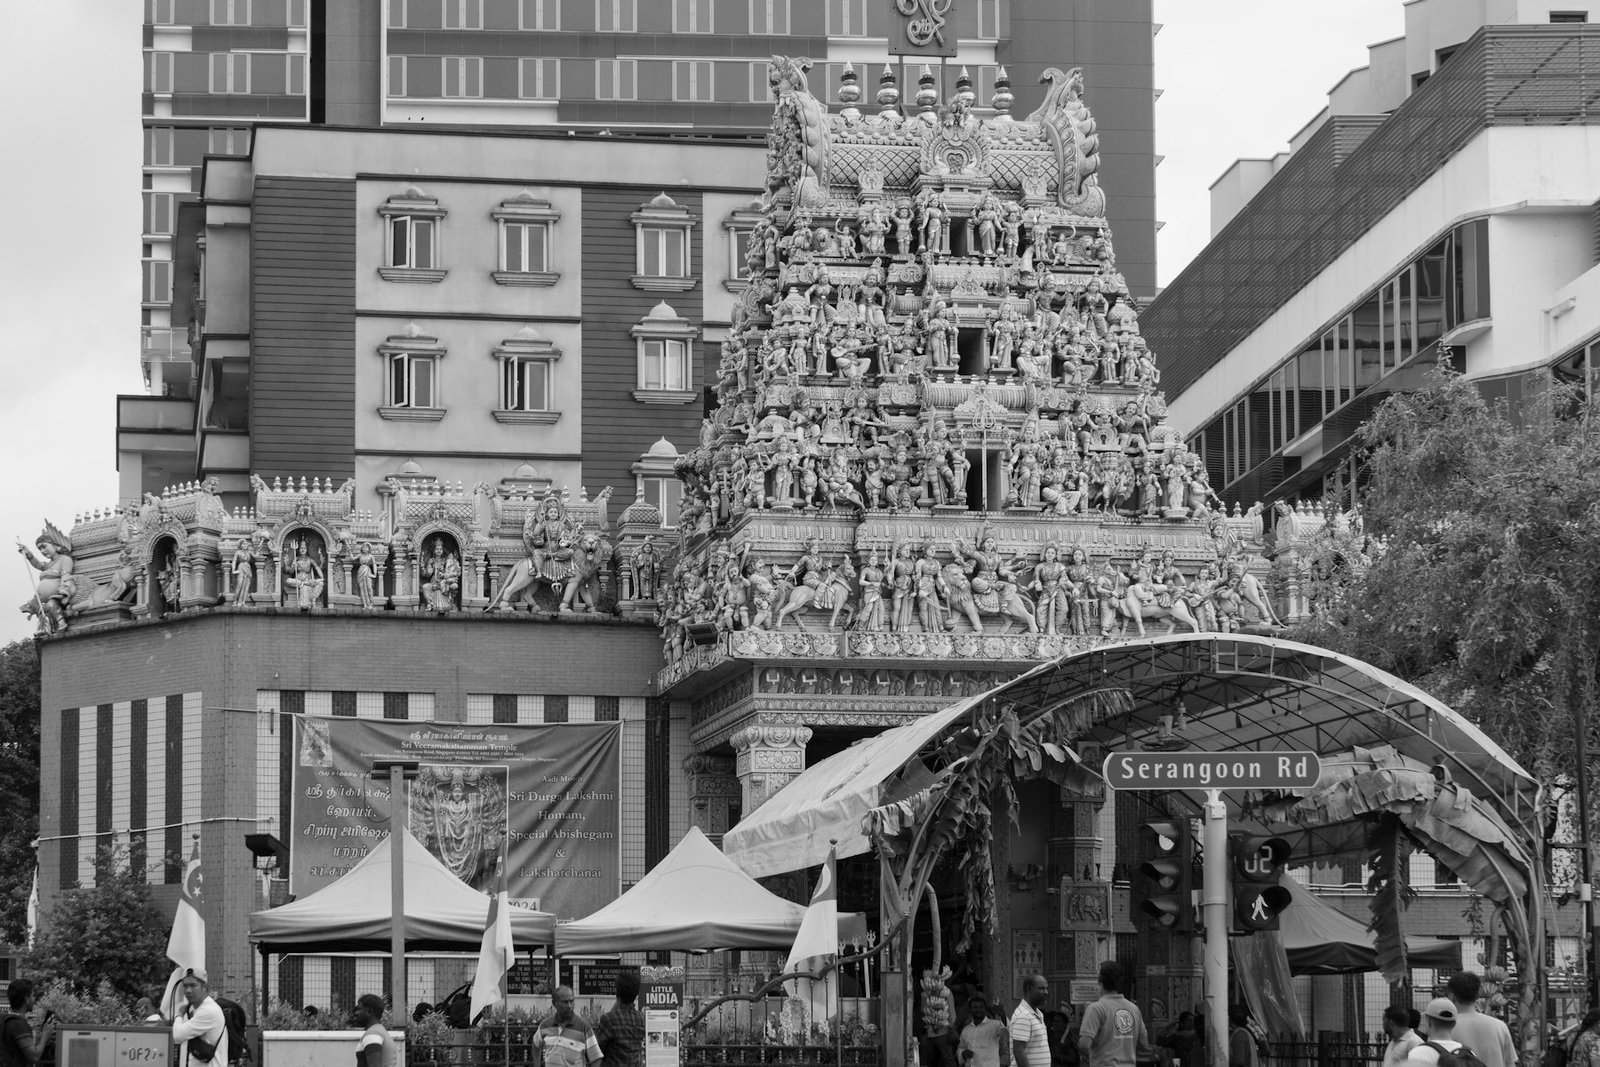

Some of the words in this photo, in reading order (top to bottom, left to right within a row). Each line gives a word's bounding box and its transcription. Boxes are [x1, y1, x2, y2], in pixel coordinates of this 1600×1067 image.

[401, 741, 412, 749] Sri
[489, 743, 518, 752] Temple
[1121, 757, 1261, 784] Serangoon
[1278, 757, 1308, 778] Rd
[510, 791, 525, 801] Sri
[528, 791, 562, 803] Durga
[566, 790, 613, 801] Lakshmi
[538, 810, 586, 822] Homam,
[510, 829, 548, 842] Special
[551, 828, 613, 841] Abishegam
[555, 848, 566, 858] &
[520, 867, 602, 878] Laksharchanai
[508, 901, 538, 911] 024
[646, 993, 679, 1005] INDIA
